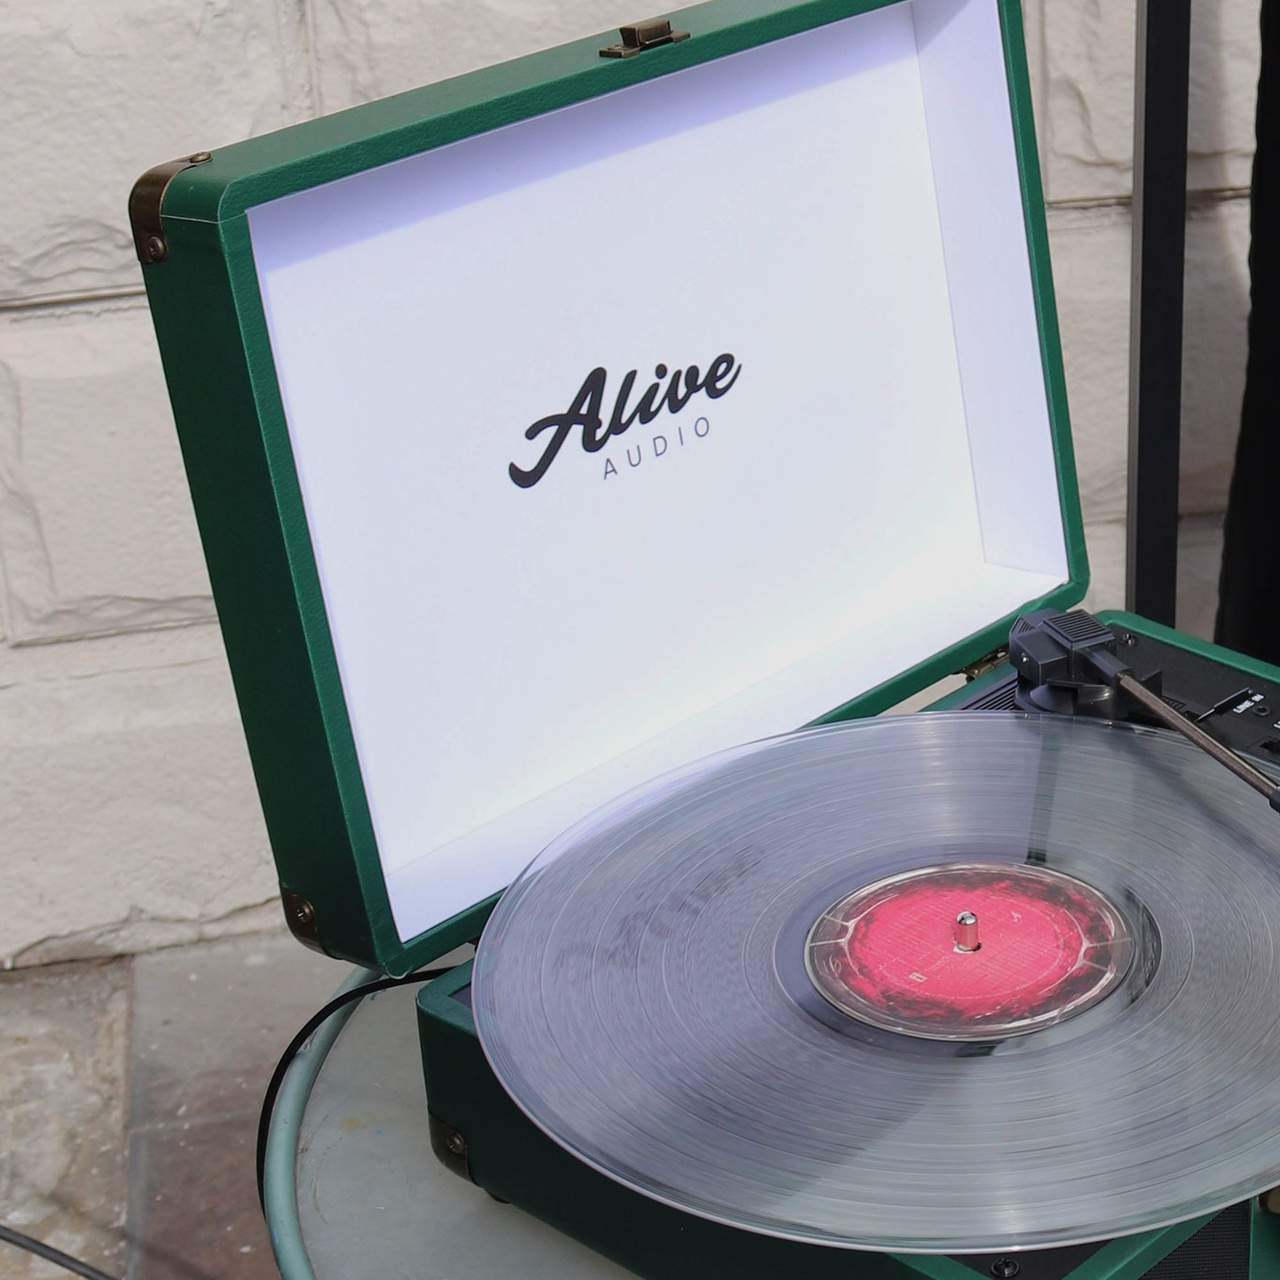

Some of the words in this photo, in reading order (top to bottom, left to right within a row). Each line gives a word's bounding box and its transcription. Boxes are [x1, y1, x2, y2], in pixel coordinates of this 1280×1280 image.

[509, 353, 742, 488] Alive
[603, 417, 710, 480] AUDIO
[1233, 699, 1254, 714] LINE
[1251, 693, 1265, 702] IN
